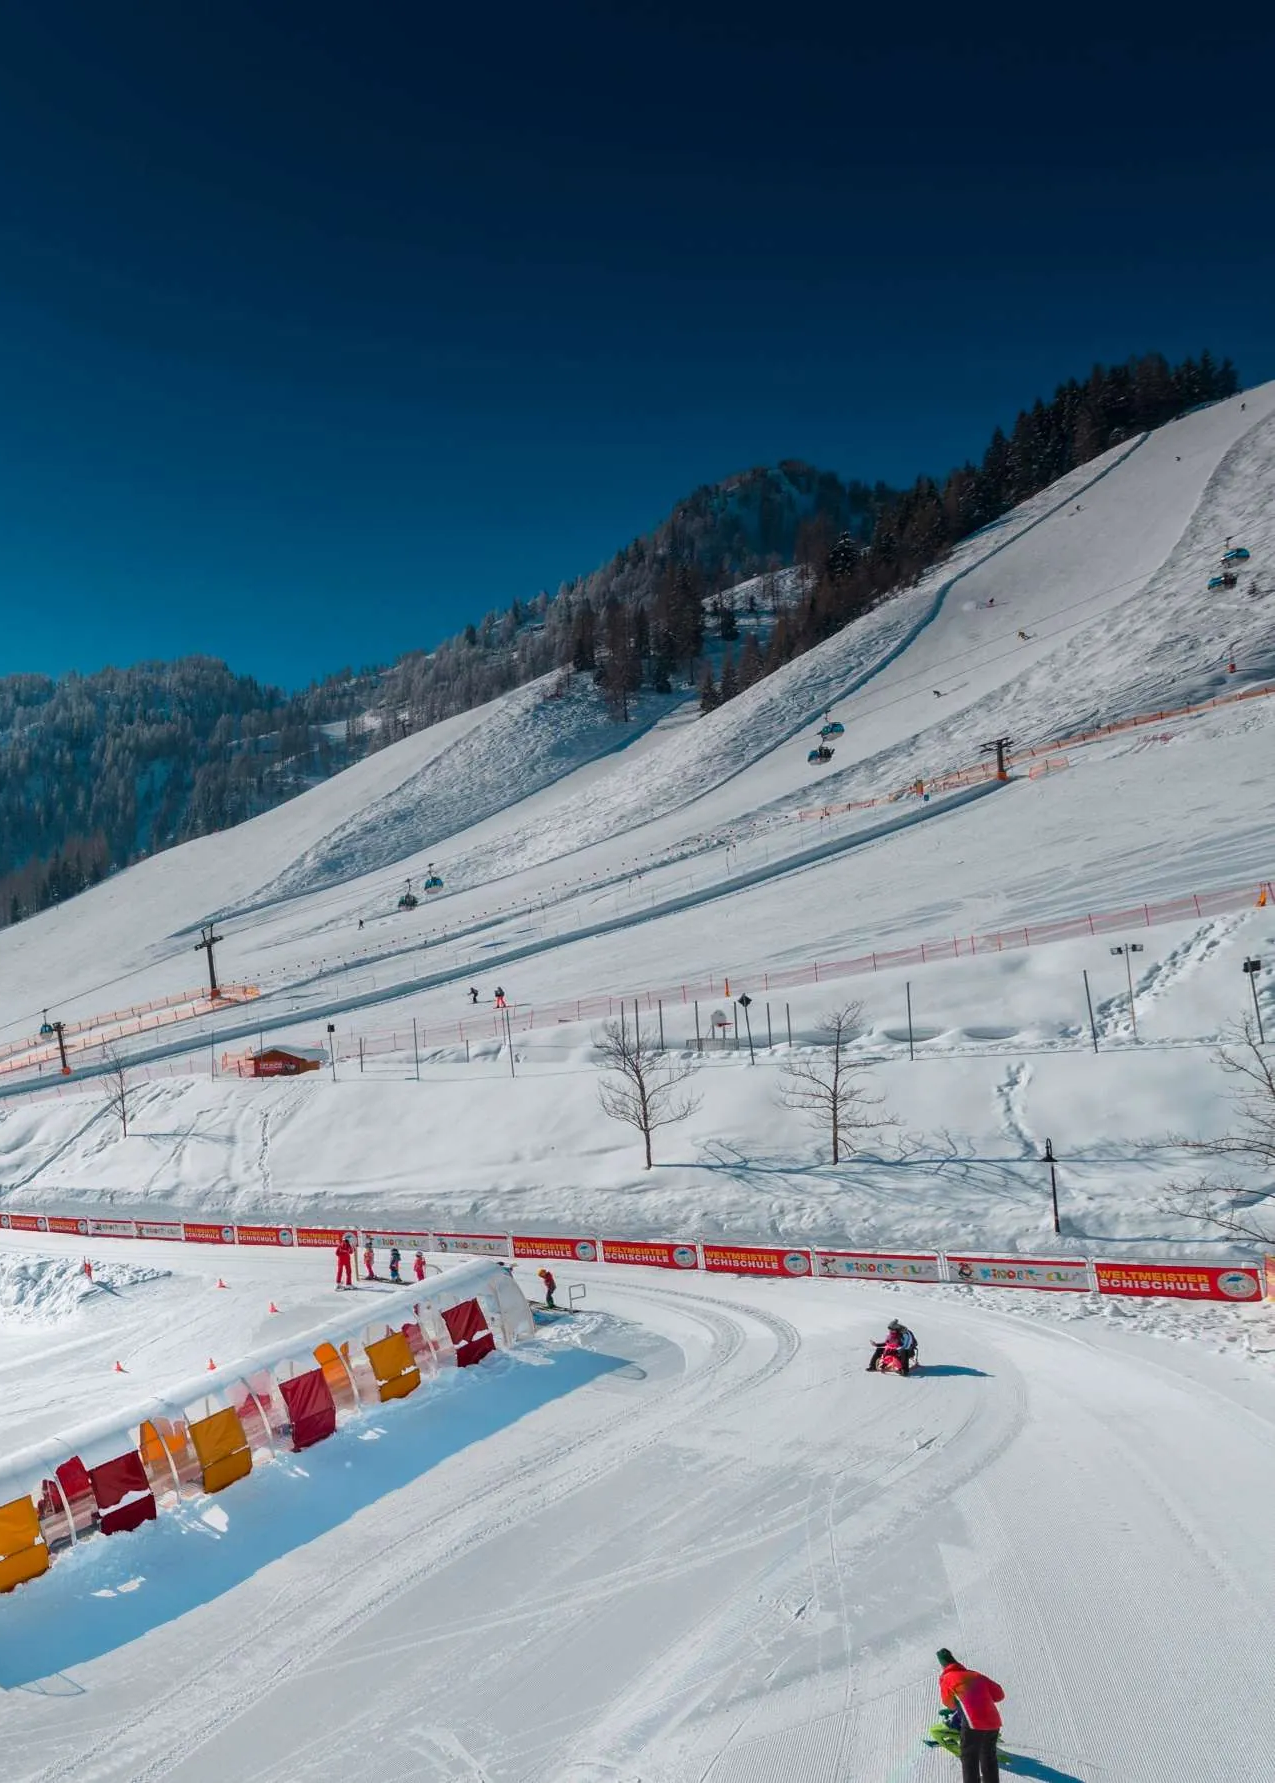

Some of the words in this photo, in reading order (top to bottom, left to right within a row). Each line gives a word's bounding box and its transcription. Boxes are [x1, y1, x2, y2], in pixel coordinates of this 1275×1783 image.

[514, 1241, 571, 1250] WELTMEISTER
[604, 1245, 668, 1255] WELTMEISTER
[515, 1247, 572, 1257] SCHISCHULE
[605, 1252, 669, 1263] SCHISCHULE
[705, 1250, 777, 1262] WELTMEISTER
[706, 1258, 779, 1269] SCHISCHULE
[1098, 1270, 1209, 1283] WELTMEISTER
[1100, 1278, 1211, 1292] SCHISCHULE
